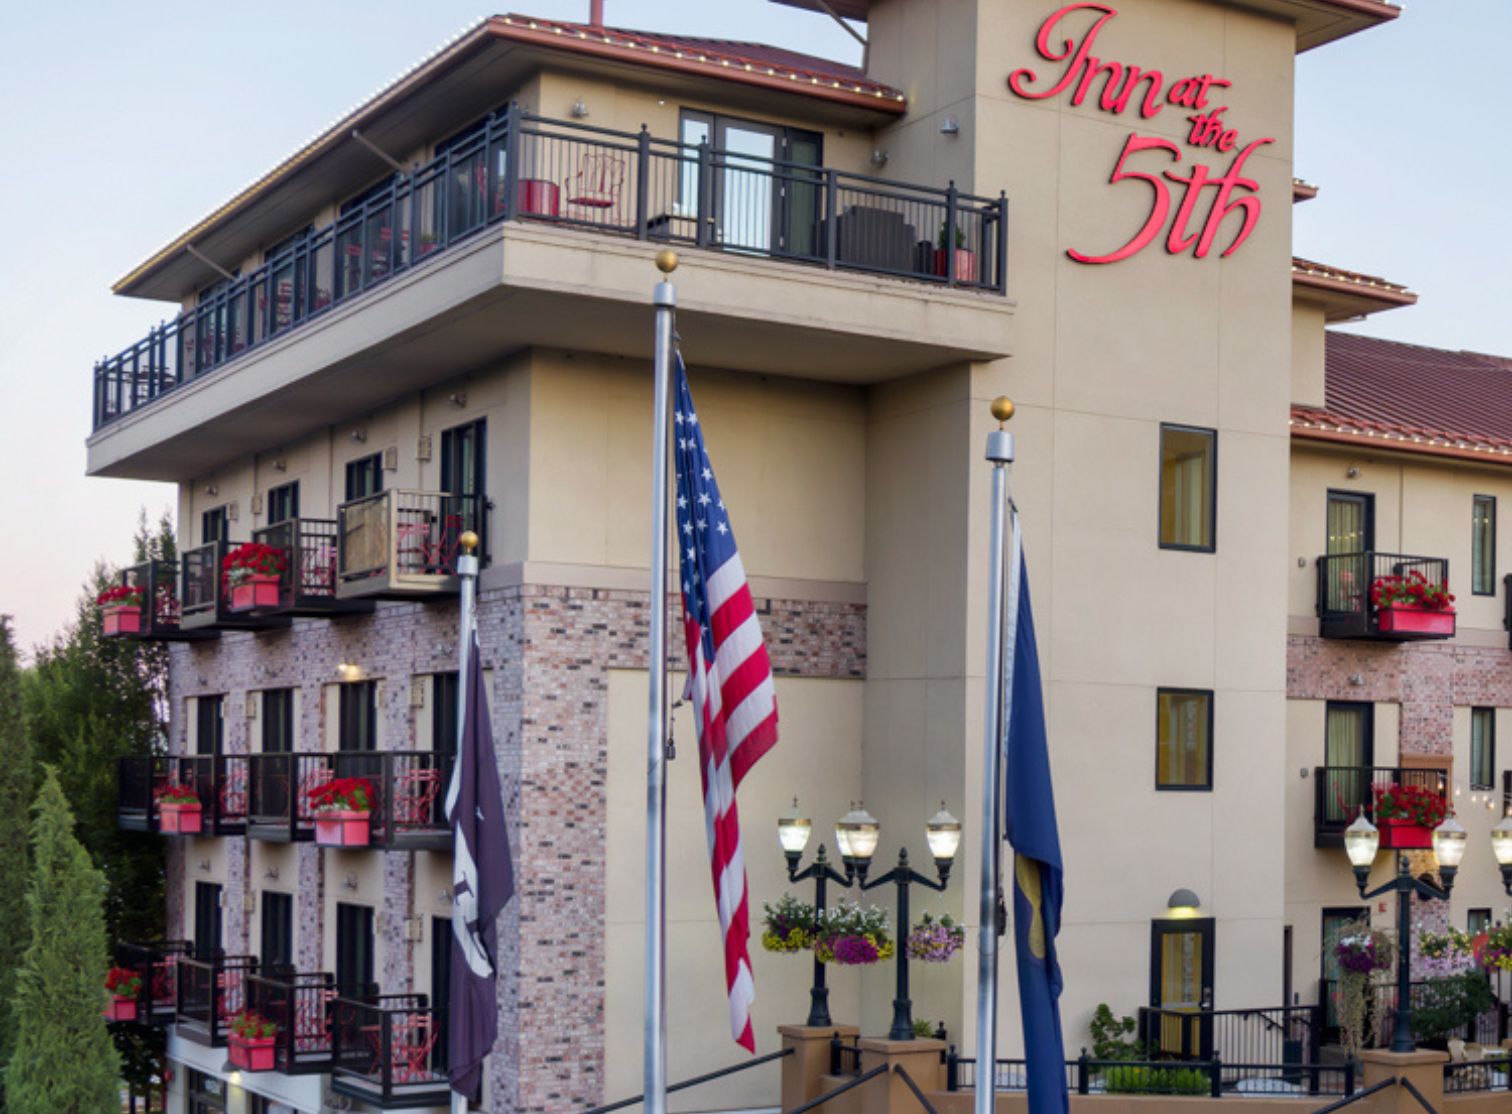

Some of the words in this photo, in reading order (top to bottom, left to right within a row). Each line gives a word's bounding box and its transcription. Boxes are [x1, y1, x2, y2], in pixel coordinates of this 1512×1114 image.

[1008, 2, 1164, 119] Inn
[1167, 73, 1232, 110] at
[1187, 106, 1239, 153] the
[1066, 132, 1276, 264] 5th
